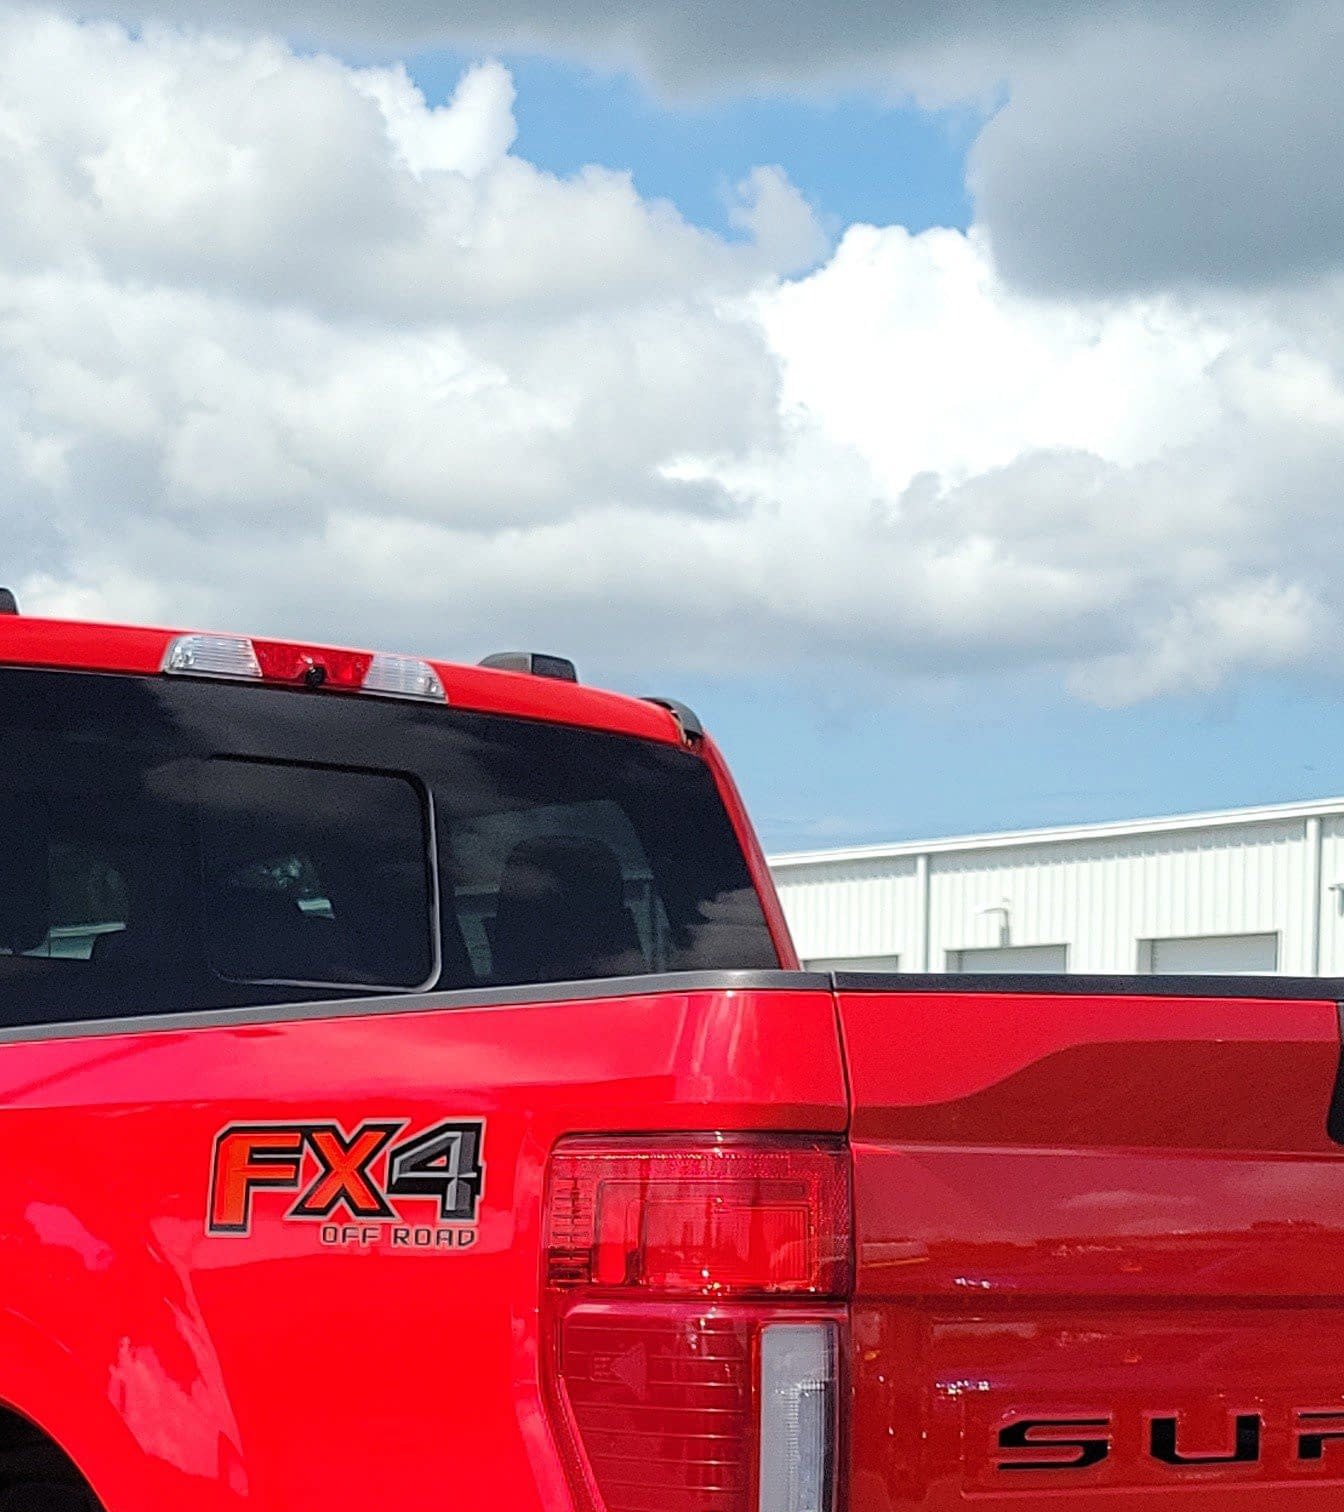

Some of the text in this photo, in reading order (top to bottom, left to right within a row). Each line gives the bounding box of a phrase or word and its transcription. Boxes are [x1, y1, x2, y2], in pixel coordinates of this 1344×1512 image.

[205, 1116, 486, 1238] FX4
[322, 1225, 477, 1247] OFF ROAD
